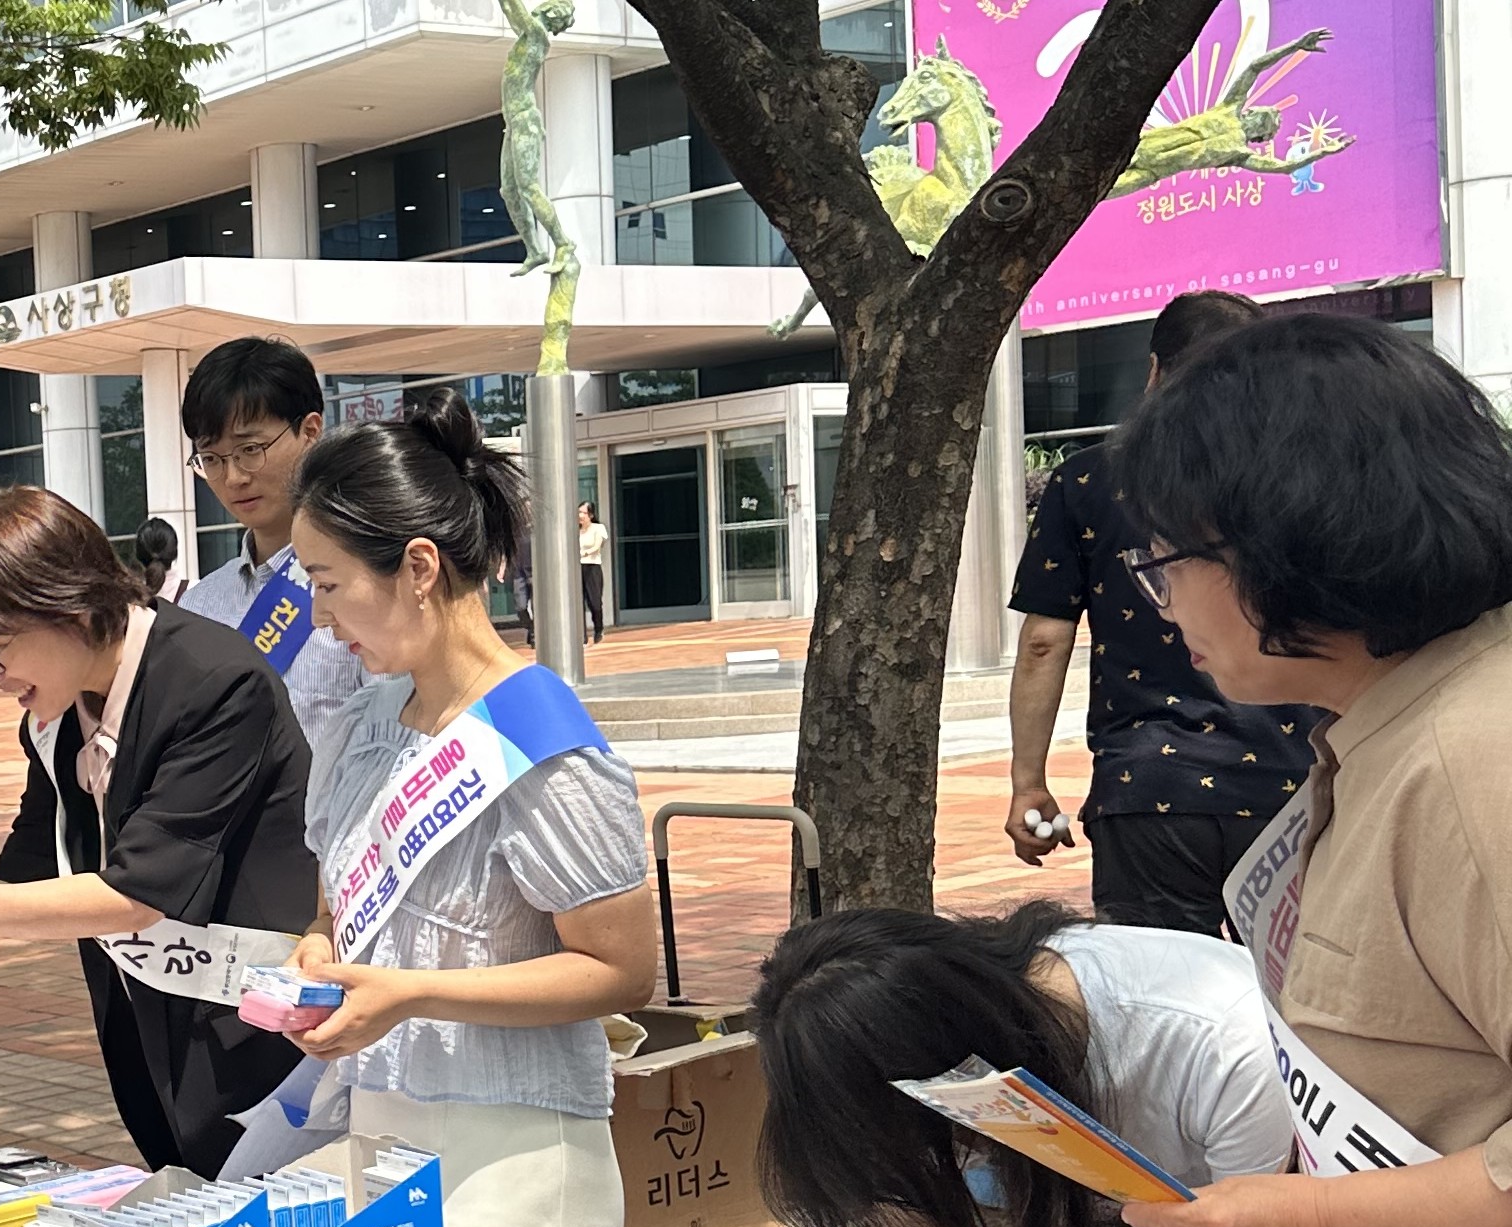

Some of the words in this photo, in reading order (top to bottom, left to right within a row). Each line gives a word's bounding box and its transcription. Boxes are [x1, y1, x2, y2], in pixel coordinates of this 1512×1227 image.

[1136, 185, 1216, 225] 정원도시
[1222, 176, 1266, 208] 사상
[27, 275, 131, 334] 사상구청
[1056, 280, 1175, 311] anniversary
[1187, 278, 1207, 292] of
[1220, 257, 1340, 288] sasang-gu
[254, 597, 300, 654] 건강
[380, 738, 466, 841] 올바른
[399, 768, 486, 868] 감염병
[647, 1159, 730, 1207] 리더스
